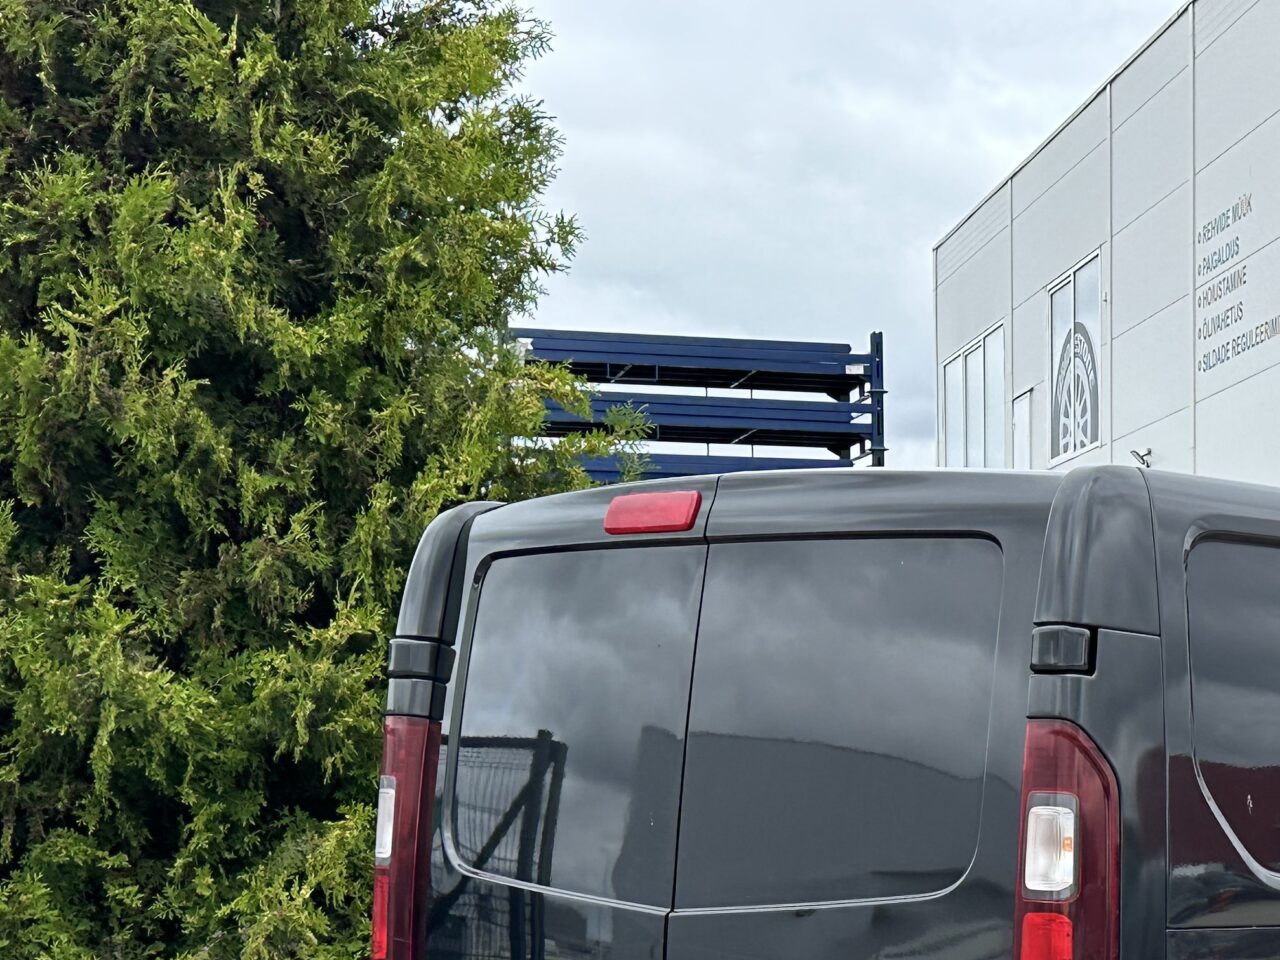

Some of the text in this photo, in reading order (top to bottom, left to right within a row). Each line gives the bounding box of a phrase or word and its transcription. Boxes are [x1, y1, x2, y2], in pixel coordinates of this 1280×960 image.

[1203, 208, 1230, 244] REHVIDE
[1202, 235, 1240, 276] PAIGALDUS
[1202, 265, 1247, 308] HOIUSTAMINE
[1202, 341, 1231, 372] SILDADE
